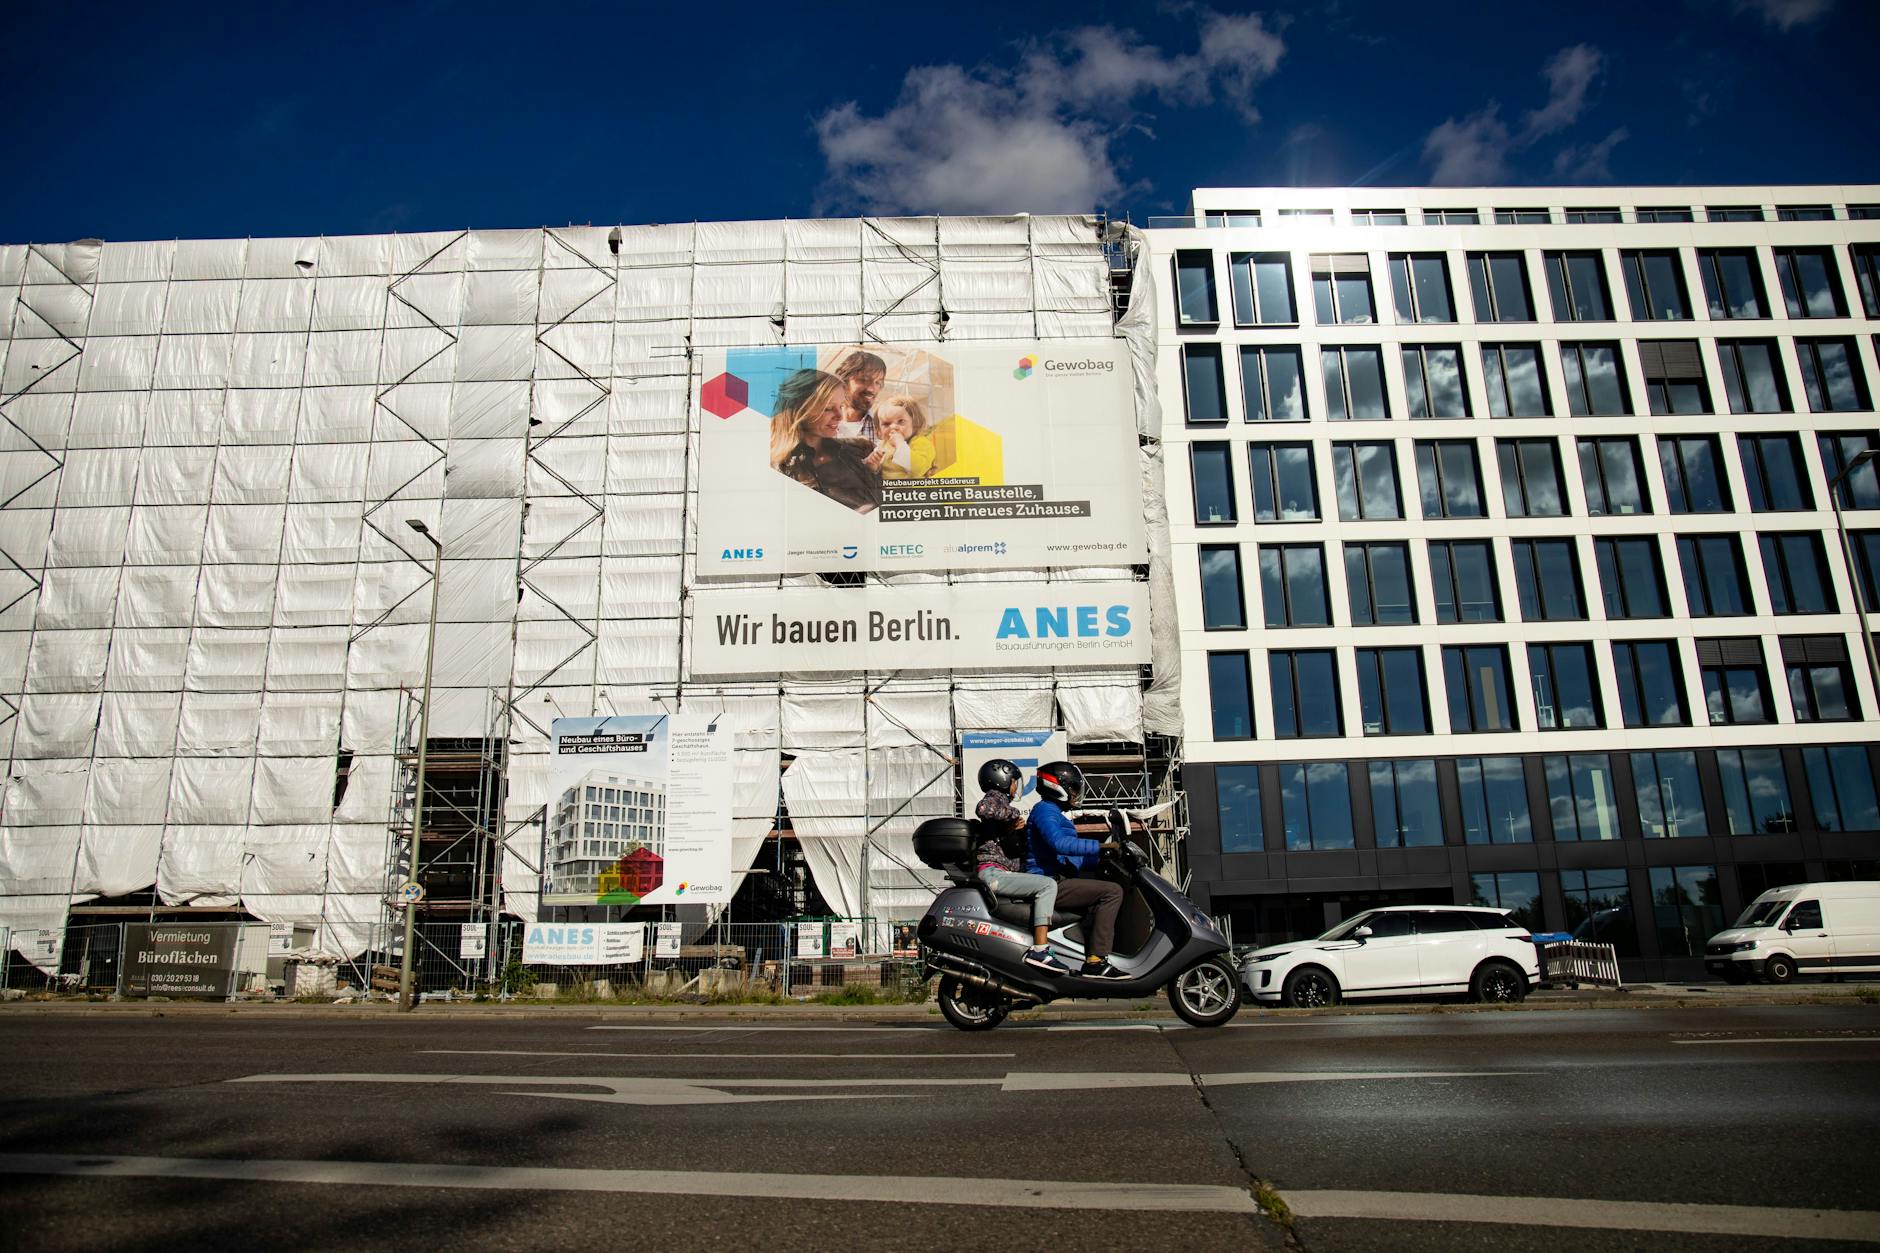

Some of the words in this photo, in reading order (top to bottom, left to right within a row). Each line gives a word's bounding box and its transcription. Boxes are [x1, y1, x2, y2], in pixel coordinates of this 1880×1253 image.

[1044, 359, 1114, 372] Gewobag
[882, 478, 939, 486] Neubauprojekt
[882, 490, 927, 502] Heute
[930, 488, 961, 500] eine
[964, 486, 1037, 500] Baustelle,
[882, 507, 942, 521] morgen
[944, 506, 965, 518] Ihr
[968, 505, 1013, 516] neues
[1016, 504, 1084, 516] Zuhause.
[722, 548, 764, 559] ANES
[880, 544, 924, 555] NETEC
[1046, 542, 1128, 552] www.gewobag.de
[716, 614, 763, 646] Wir
[772, 613, 857, 644] bauen
[869, 610, 960, 642] Berlin.
[996, 605, 1132, 638] ANES
[1078, 640, 1100, 648] Berlin
[1102, 640, 1133, 648] GmbH
[150, 931, 210, 944] Vermietung
[528, 927, 594, 945] ANES
[138, 951, 218, 964] Büroflächen
